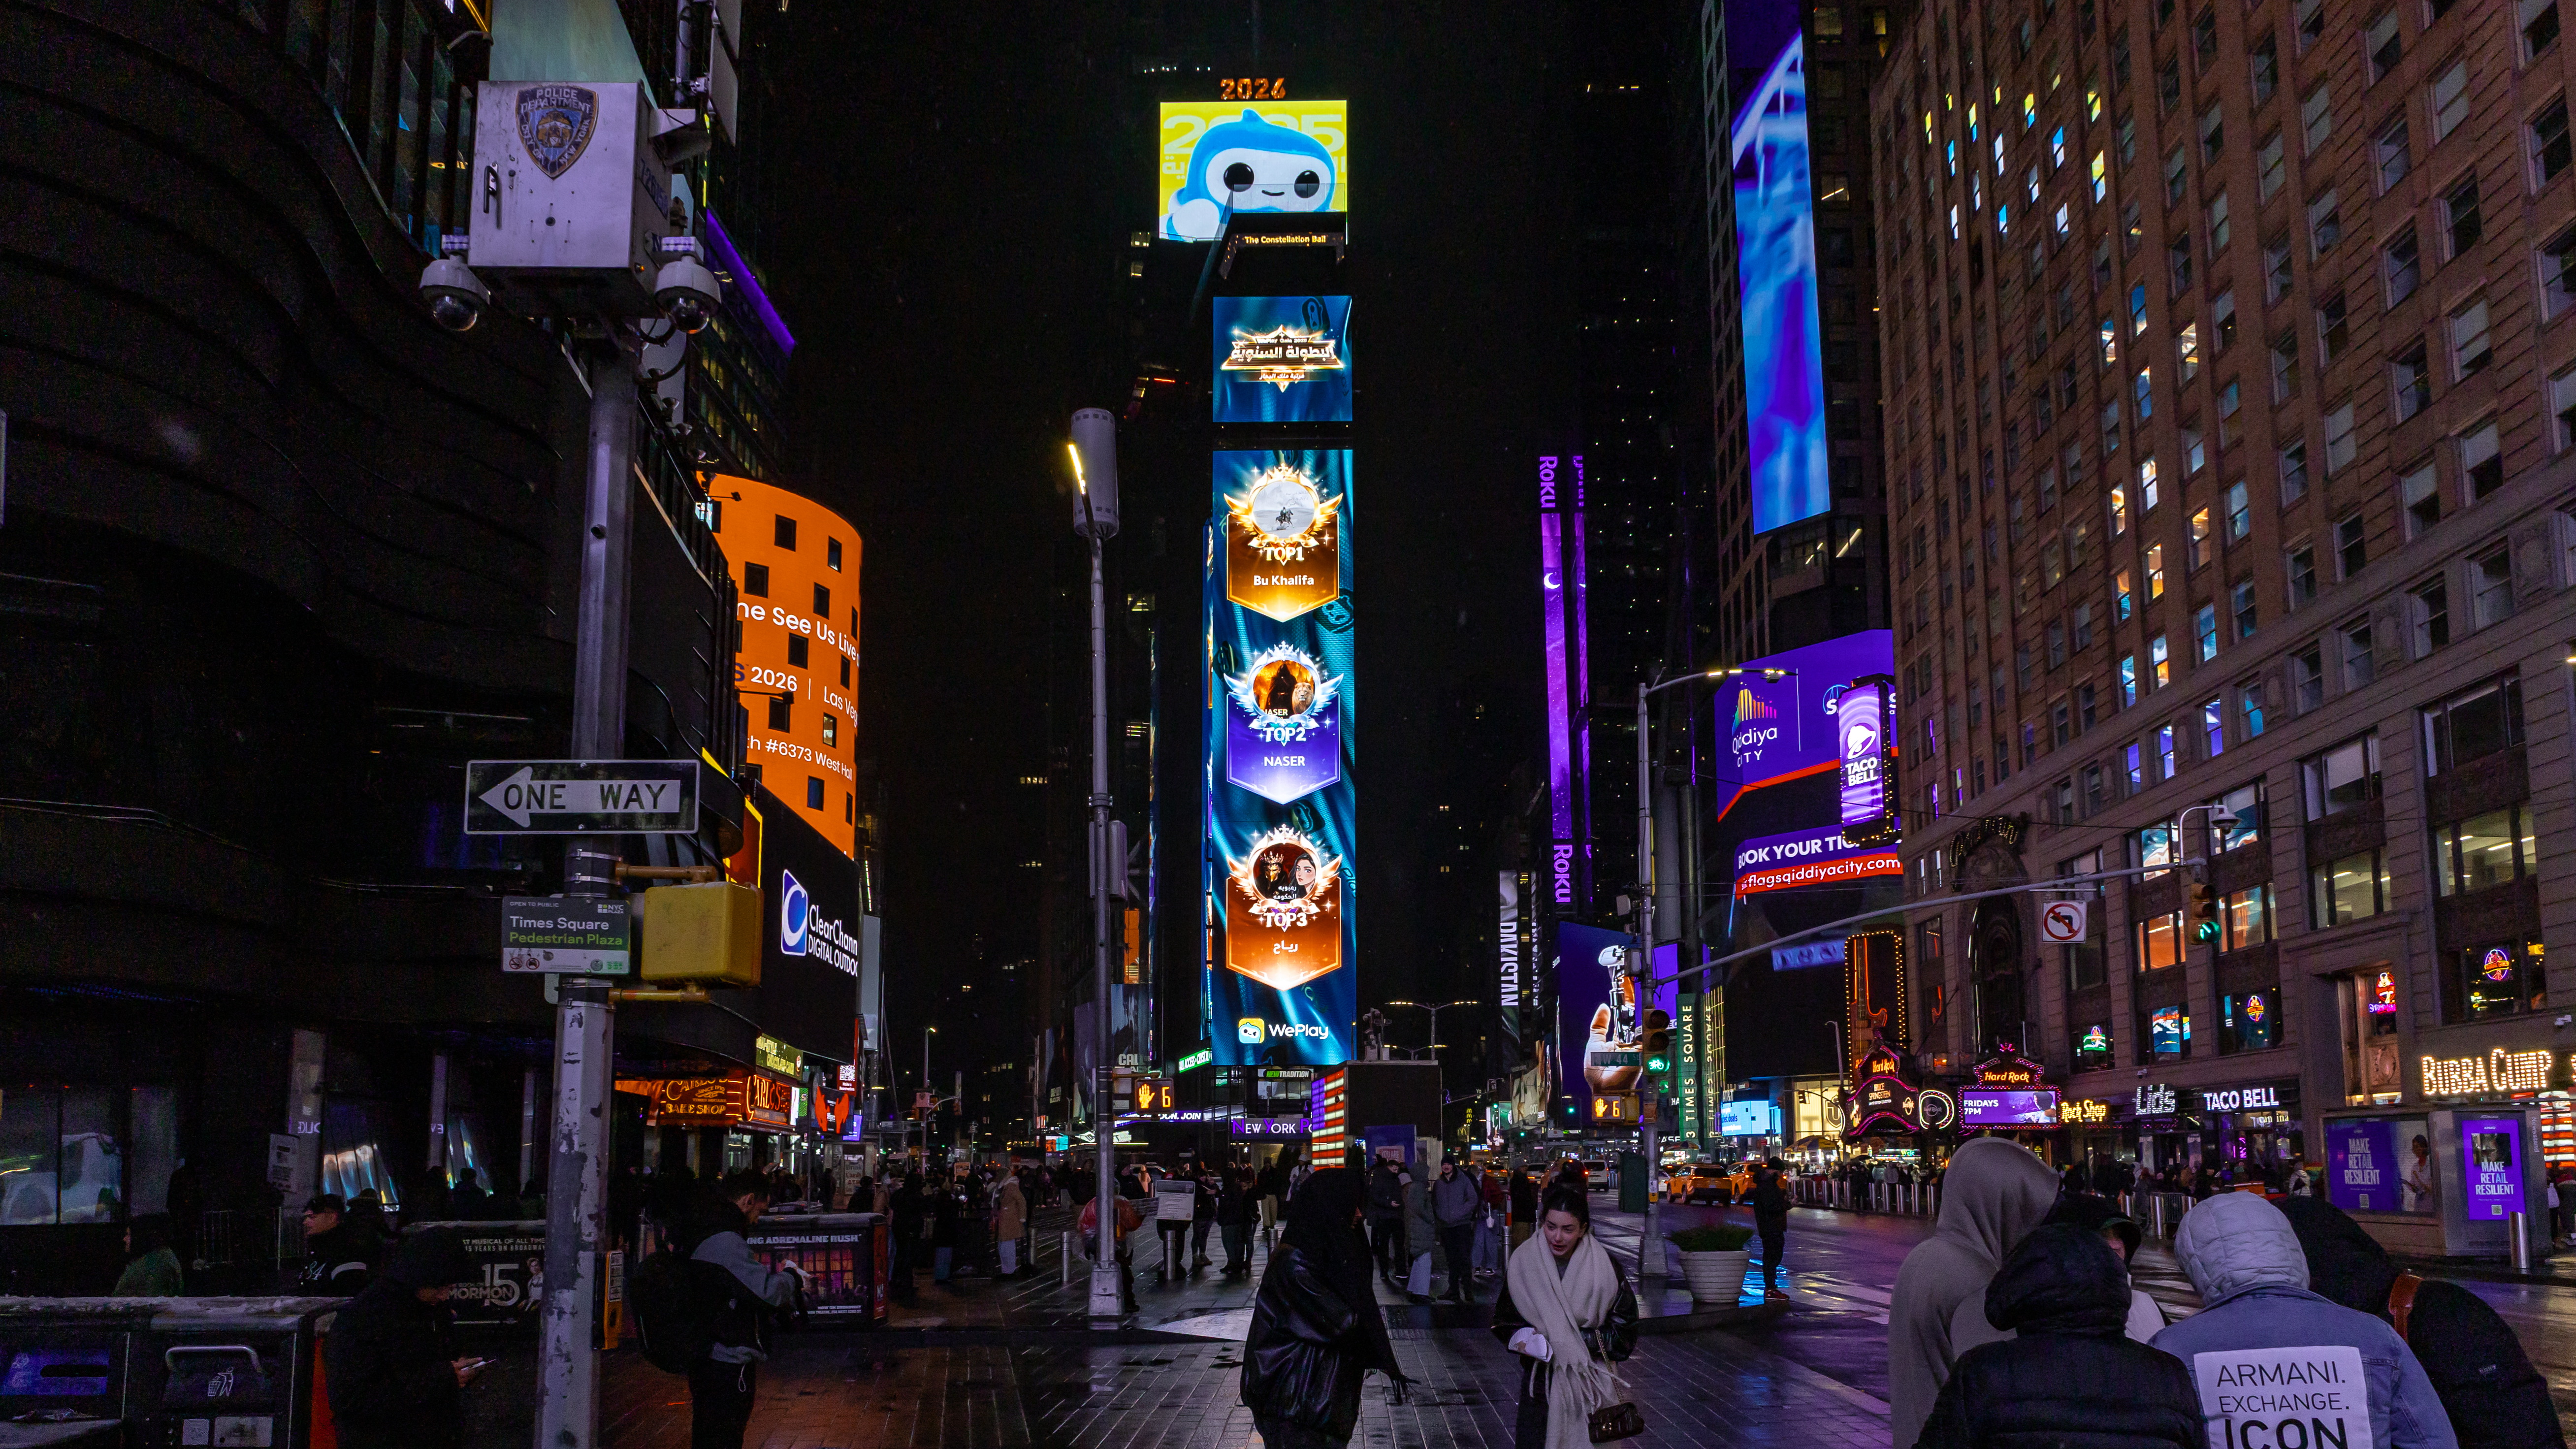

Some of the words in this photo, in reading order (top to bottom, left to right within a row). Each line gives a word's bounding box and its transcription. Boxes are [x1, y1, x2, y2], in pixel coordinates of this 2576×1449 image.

[537, 88, 578, 98] POLICE
[1220, 78, 1287, 99] 2026
[520, 97, 591, 114] DEPARTMENT
[1261, 235, 1310, 244] Constellation
[1312, 234, 1326, 243] Ball
[1264, 547, 1304, 561] TOP1
[1254, 575, 1269, 586] Bu
[1272, 575, 1314, 586] Khalifa
[773, 607, 811, 634] See
[816, 621, 835, 645] Us
[838, 632, 856, 661] Live
[751, 666, 798, 692] 2026
[824, 686, 843, 710] Las
[1263, 727, 1307, 742] TOP2
[1733, 727, 1778, 754] Qiddiya
[765, 738, 812, 762] #6373
[815, 751, 840, 773] West
[841, 762, 853, 782] Hall
[1264, 756, 1305, 767] NASER
[1845, 757, 1878, 775] TACO
[1848, 771, 1878, 787] BELL
[504, 784, 566, 810] ONE
[599, 783, 667, 810] WAY
[1738, 847, 1770, 869] BOOK
[1773, 839, 1822, 860] YOUR
[509, 916, 553, 929] Times
[557, 917, 610, 932] Square
[1263, 912, 1307, 928] TOP3
[510, 932, 583, 944] Pedestrian
[586, 934, 623, 945] Plaza
[808, 934, 833, 965] DIGITAL
[1269, 1024, 1329, 1040] WePlay
[1682, 1005, 1694, 1063] SQUARE
[1616, 1054, 1628, 1064] 44
[1872, 1060, 1883, 1073] Hard
[1884, 1057, 1895, 1073] Rock
[1985, 1072, 2006, 1081] Hard
[2008, 1072, 2029, 1083] Rock
[2421, 1056, 2489, 1095] BUBBA
[2491, 1048, 2552, 1090] GUMP
[1162, 1087, 1171, 1108] 6
[1684, 1078, 1695, 1122] TIMES
[2203, 1091, 2240, 1112] TACO
[2243, 1088, 2280, 1109] BELL
[666, 1103, 695, 1113] BAKE
[696, 1104, 726, 1114] SHOP
[1612, 1100, 1620, 1118] 6
[2061, 1102, 2083, 1123] Rock
[2083, 1099, 2106, 1122] Shop
[2259, 1113, 2289, 1123] canina
[2348, 1138, 2371, 1153] MAKE
[2348, 1154, 2374, 1169] RETAIL
[2481, 1161, 2505, 1172] MAKE
[2344, 1169, 2380, 1185] RESILIENT
[2480, 1173, 2509, 1184] RETAIL
[2475, 1184, 2515, 1195] RESILIENT
[765, 1235, 829, 1245] ADRENALINE
[481, 1263, 520, 1306] 15
[449, 1287, 515, 1299] MORMON
[2217, 1360, 2346, 1387] ARMANI.
[2219, 1393, 2350, 1413] EXCHANGE.
[2224, 1417, 2350, 1449] ICON
